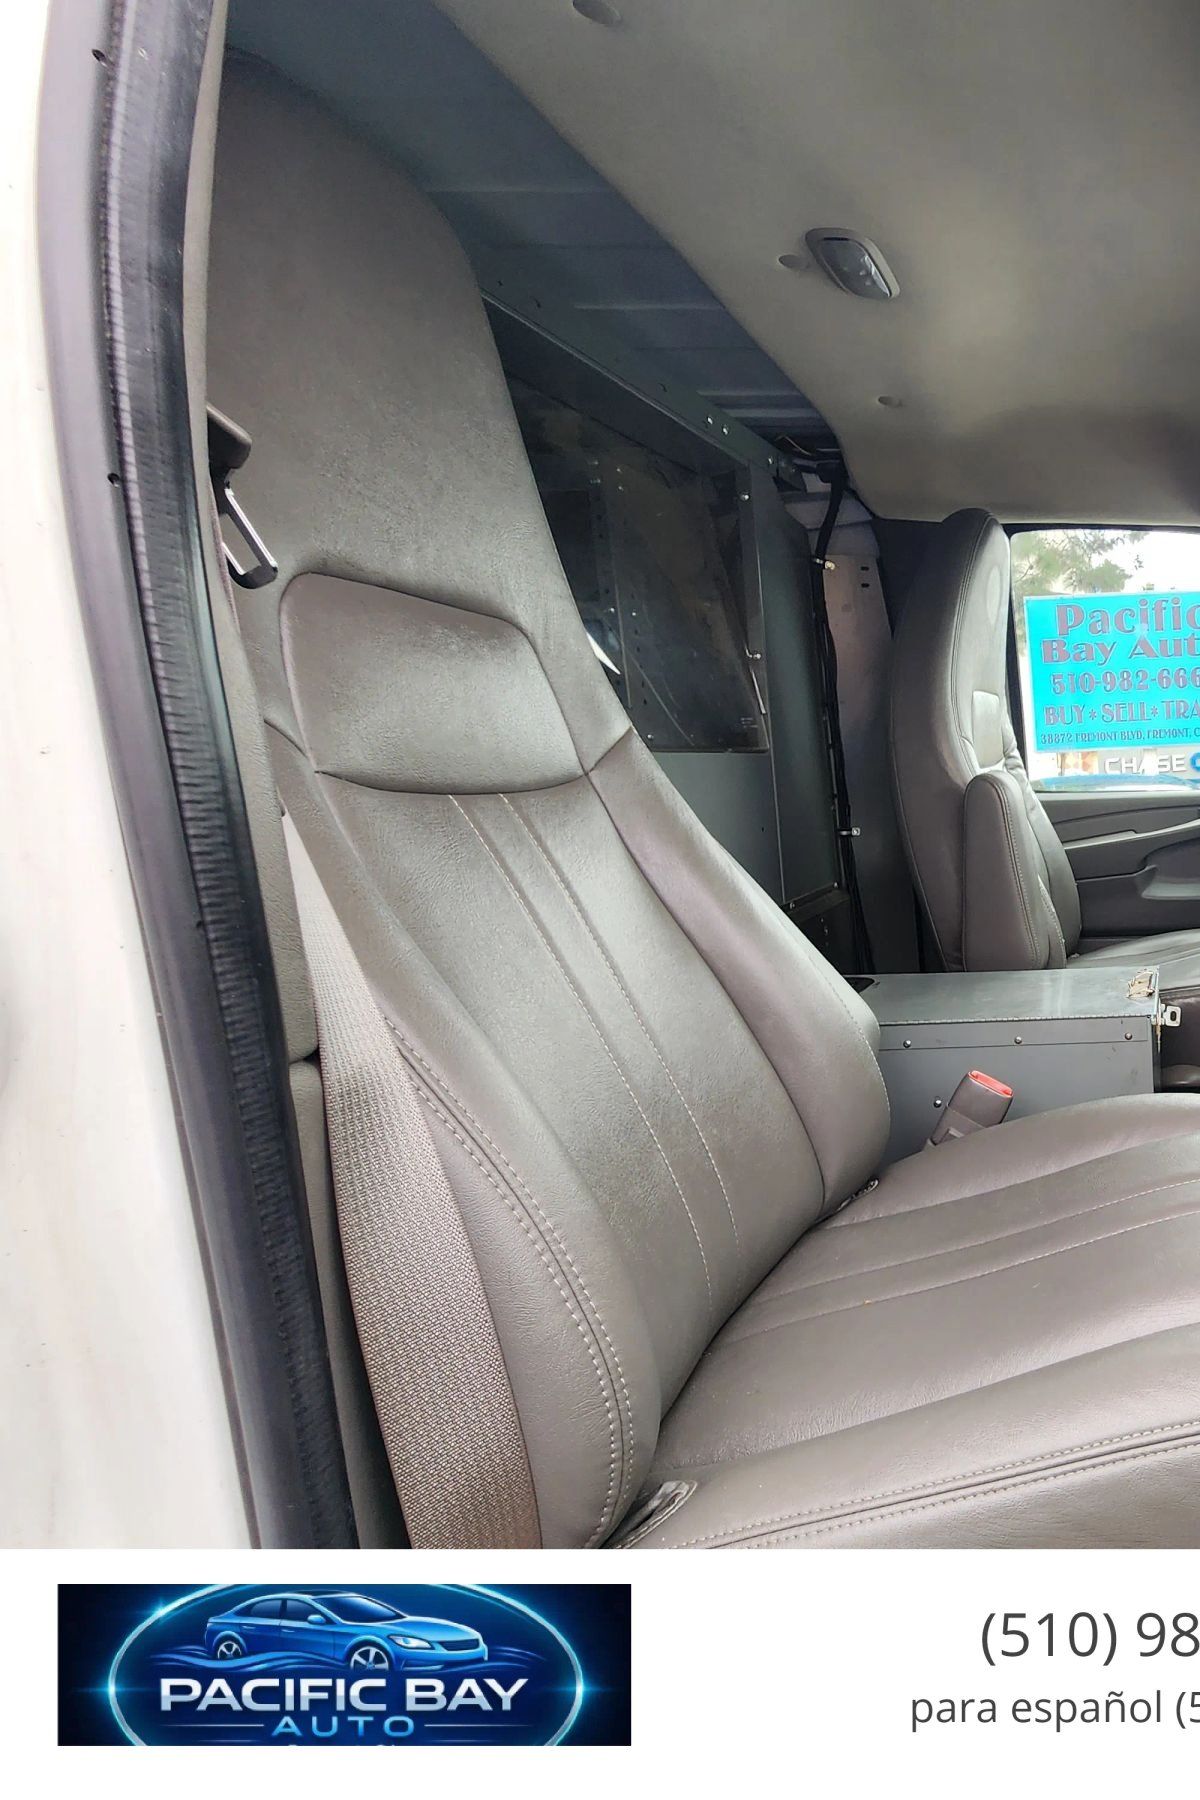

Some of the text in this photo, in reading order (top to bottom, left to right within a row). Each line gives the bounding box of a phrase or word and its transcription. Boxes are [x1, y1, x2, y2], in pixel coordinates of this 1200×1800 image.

[1042, 637, 1117, 666] Bay
[1044, 703, 1086, 726] BUY
[1101, 701, 1151, 723] SELL
